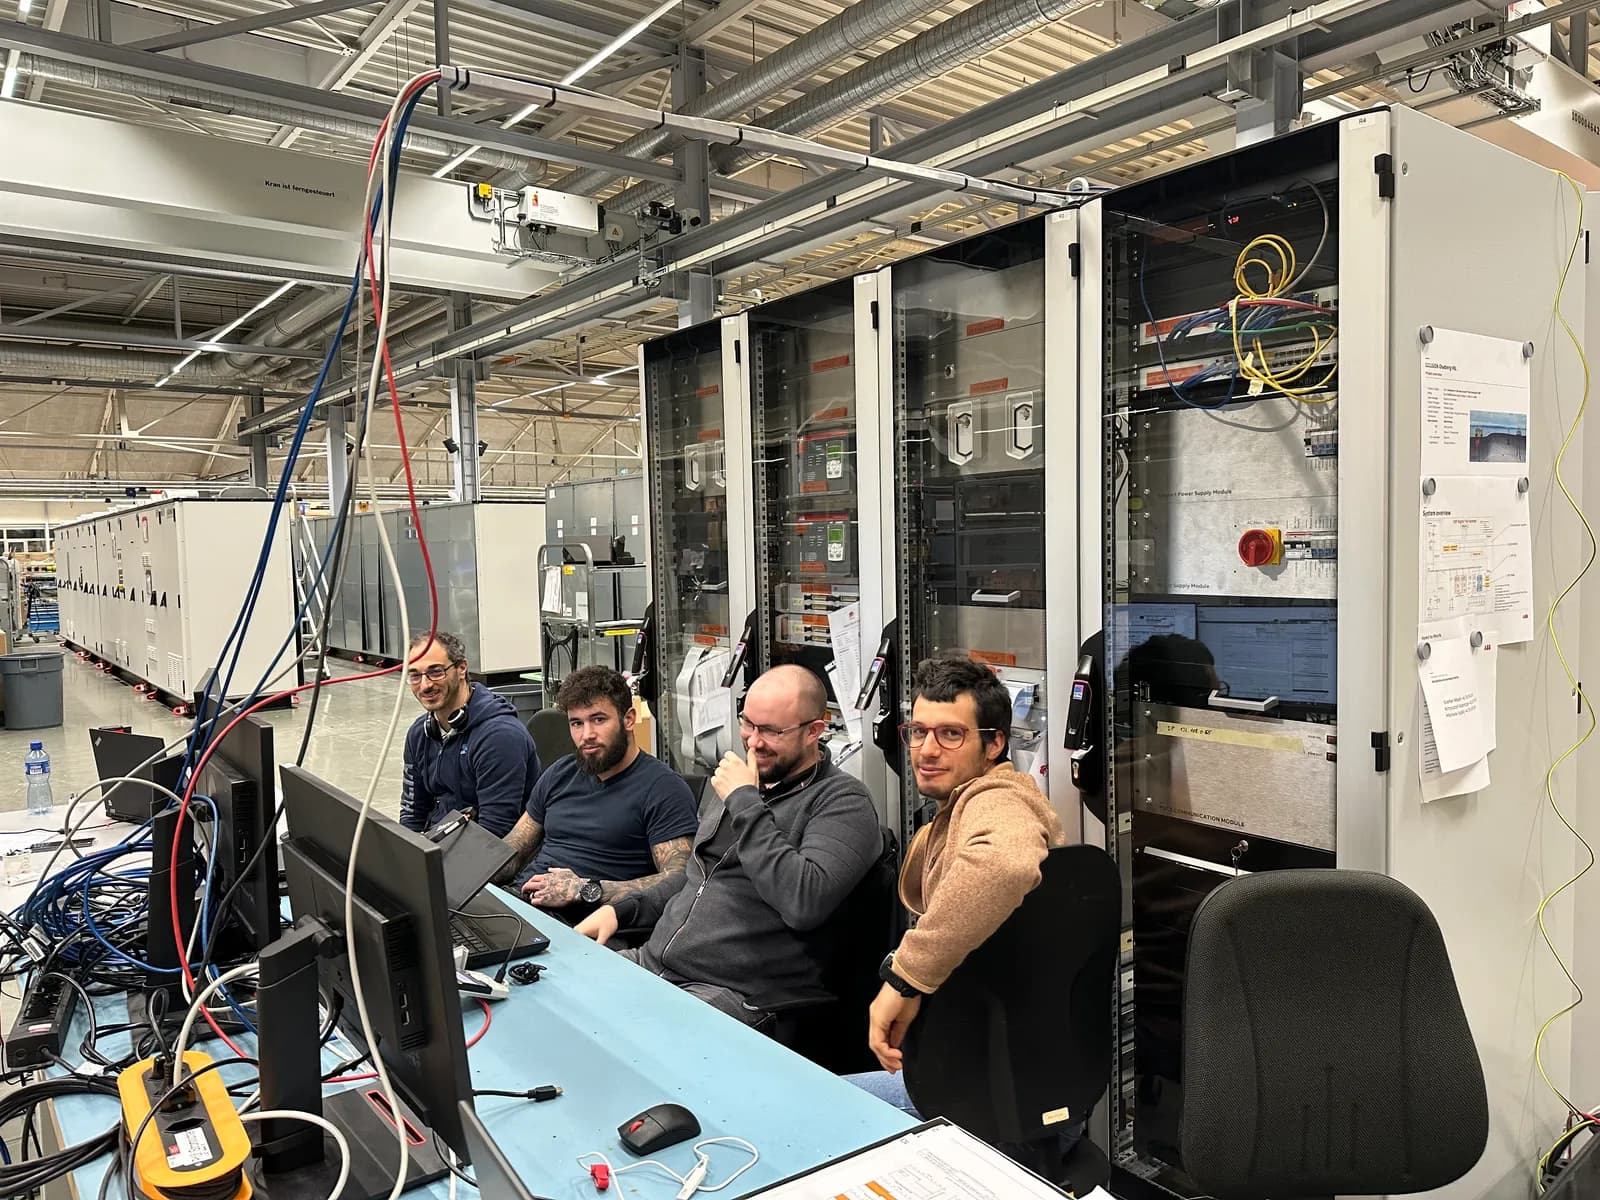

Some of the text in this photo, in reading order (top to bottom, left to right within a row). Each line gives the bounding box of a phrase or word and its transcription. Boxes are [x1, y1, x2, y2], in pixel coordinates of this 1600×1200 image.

[265, 180, 281, 188] Kran
[292, 185, 335, 197] ferngesteuert
[1177, 489, 1193, 497] Power
[1194, 488, 1212, 496] Supply
[1220, 817, 1245, 828] MODULE
